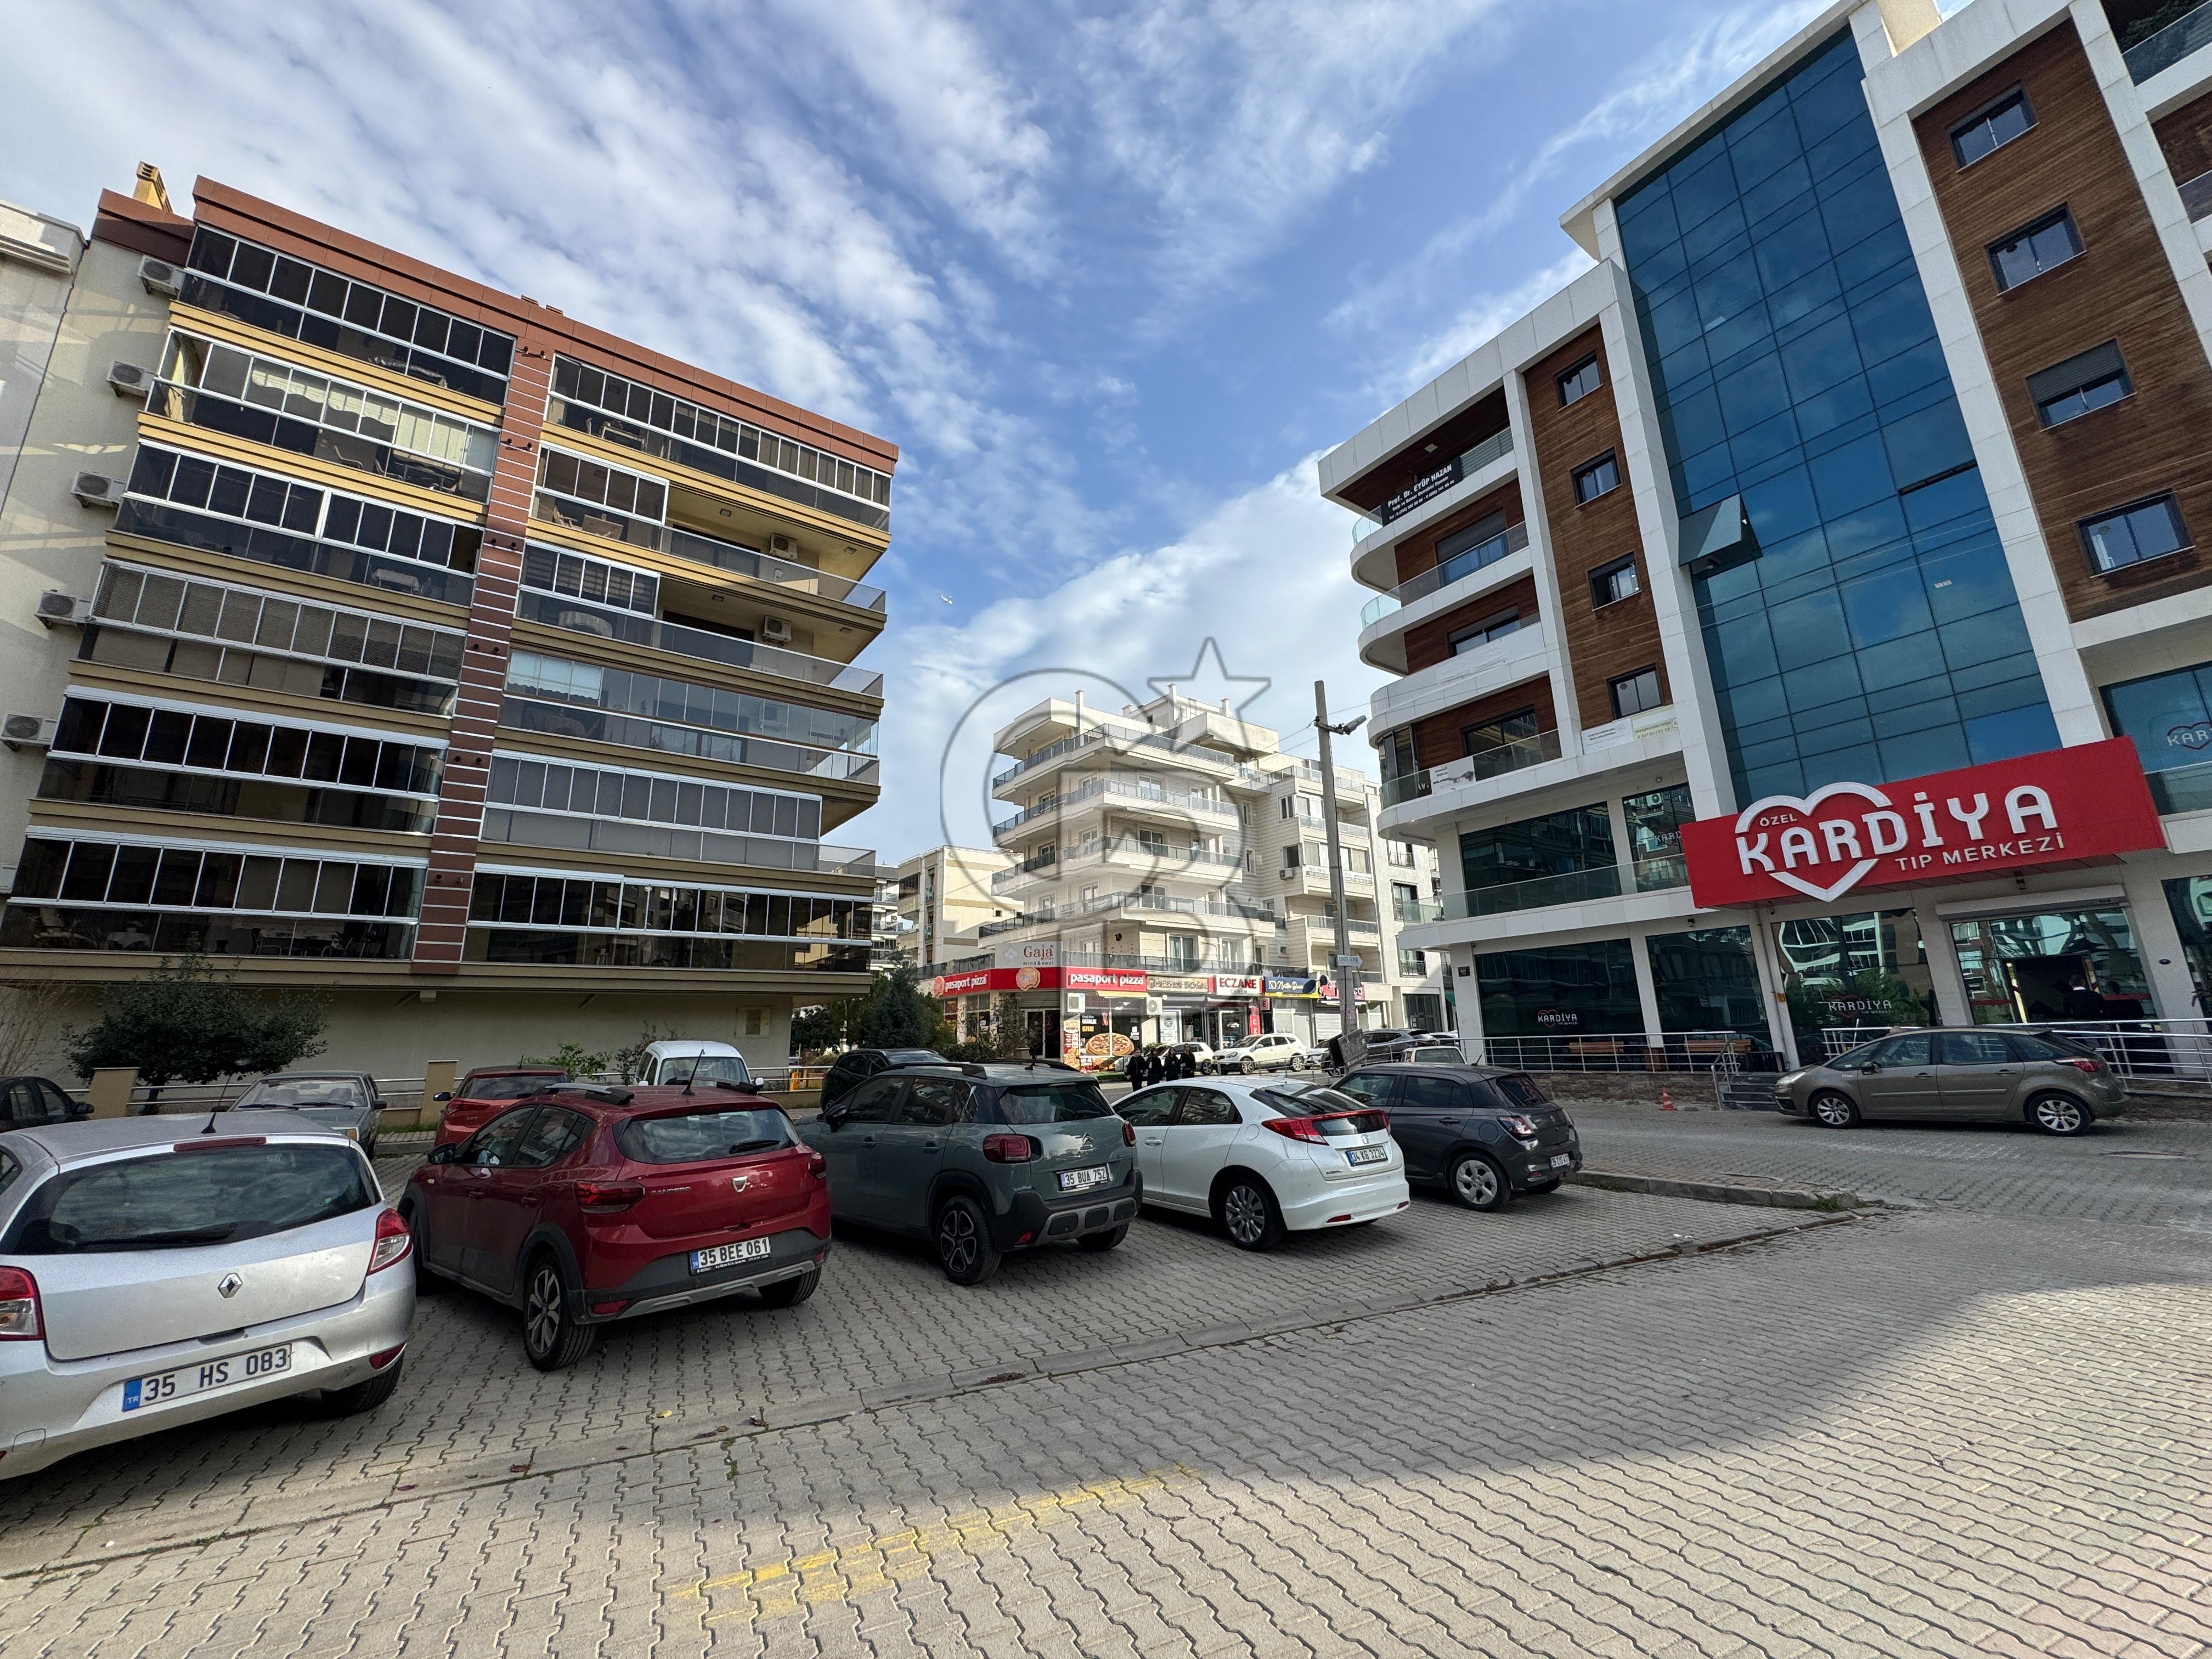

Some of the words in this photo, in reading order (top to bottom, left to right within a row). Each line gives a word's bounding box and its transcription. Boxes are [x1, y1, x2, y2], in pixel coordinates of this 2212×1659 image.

[1388, 495, 1402, 507] Prof.
[1403, 490, 1413, 498] Dr.
[1414, 477, 1430, 492] EYÜP
[1431, 464, 1452, 482] HAZAN
[2166, 728, 2212, 746] KAR
[1759, 812, 1798, 828] ÖZEL
[1735, 785, 2059, 876] KARDİYA
[1895, 855, 1932, 871] TIP
[1943, 832, 2065, 865] MERKEZİ
[945, 976, 970, 993] pasaport
[971, 974, 988, 989] pizza
[1070, 973, 1117, 986] pasaport
[1120, 974, 1146, 986] pizza
[1220, 978, 1257, 989] ECZANE
[1828, 998, 1892, 1011] KARDİYA
[1538, 1012, 1577, 1023] KARDİYA
[1369, 1148, 1385, 1159] 3234
[1065, 1173, 1075, 1185] 35
[1077, 1171, 1091, 1183] BUA
[1093, 1169, 1105, 1181] 752
[651, 1187, 691, 1196] SANDERO
[700, 1249, 716, 1266] 35
[720, 1243, 743, 1261] BEE
[747, 1239, 768, 1255] 061
[127, 1395, 139, 1403] TR
[144, 1374, 176, 1401] 35
[200, 1362, 229, 1388] HS
[246, 1348, 287, 1375] 083
